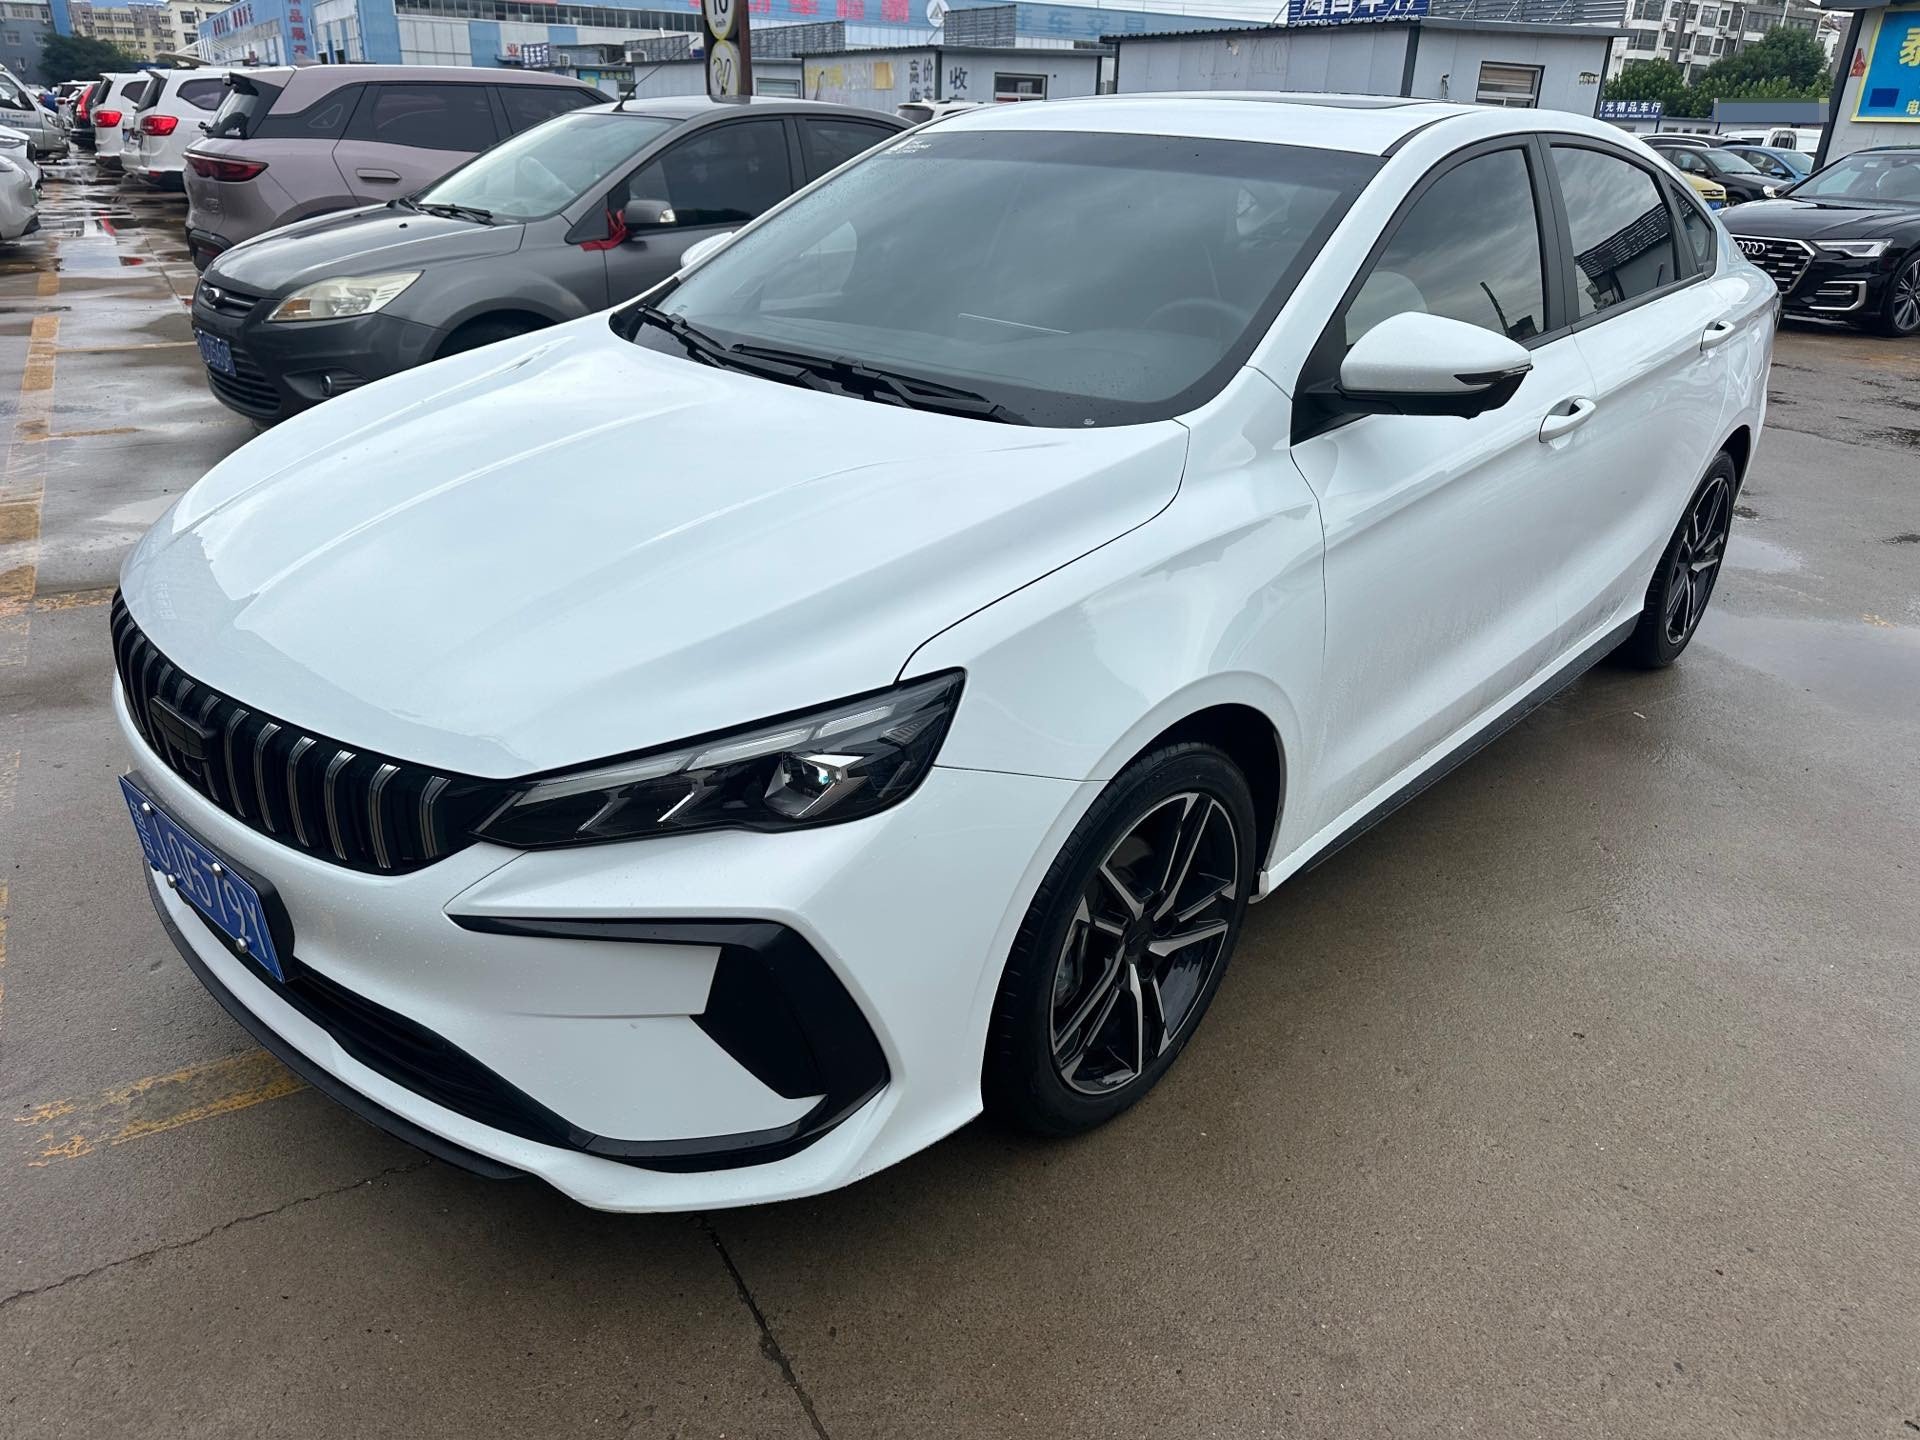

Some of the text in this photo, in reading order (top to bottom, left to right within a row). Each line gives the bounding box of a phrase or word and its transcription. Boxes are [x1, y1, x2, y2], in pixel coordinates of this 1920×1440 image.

[1600, 101, 1661, 113] 光精品车行
